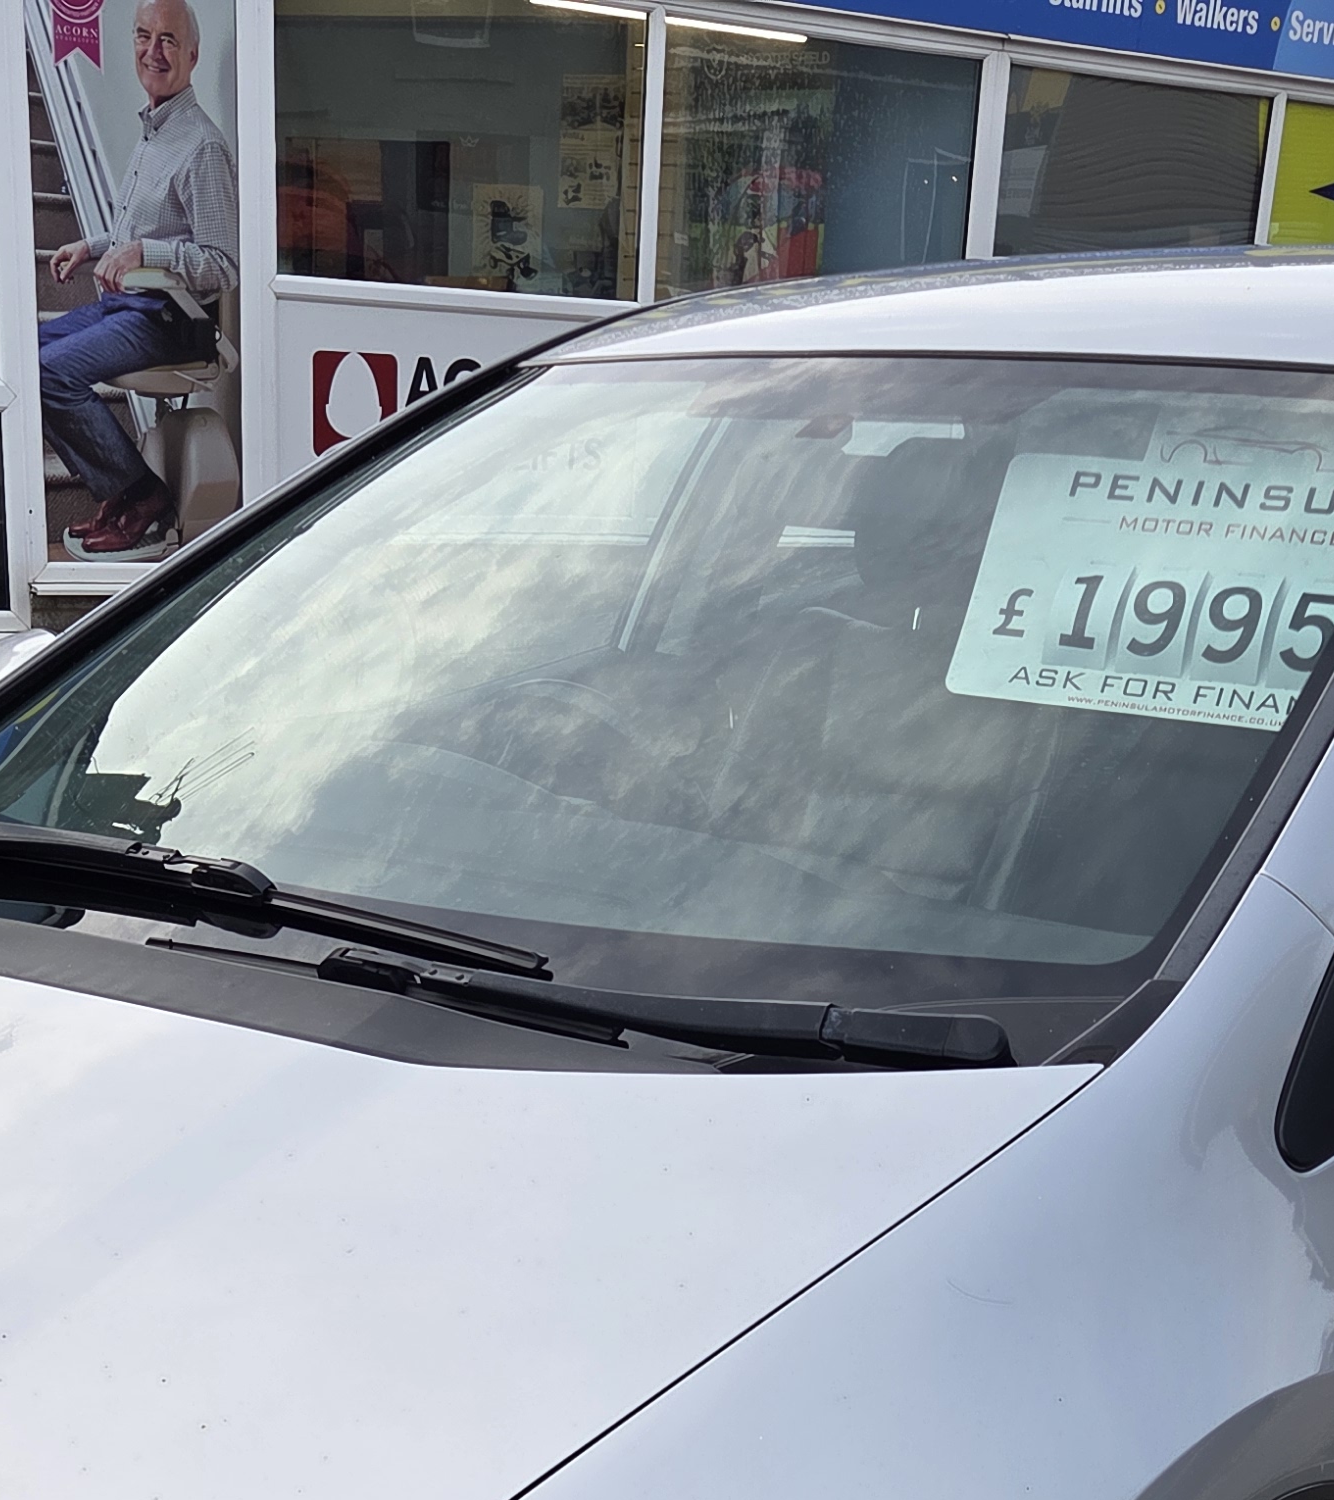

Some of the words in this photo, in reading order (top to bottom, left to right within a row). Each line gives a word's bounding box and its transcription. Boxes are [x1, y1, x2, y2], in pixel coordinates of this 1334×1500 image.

[55, 24, 99, 38] ACORN
[1176, 0, 1259, 35] Walkers
[1118, 515, 1214, 538] MOTOR
[992, 587, 1034, 638] £
[1008, 666, 1086, 691] ASK
[1099, 675, 1177, 702] FOR
